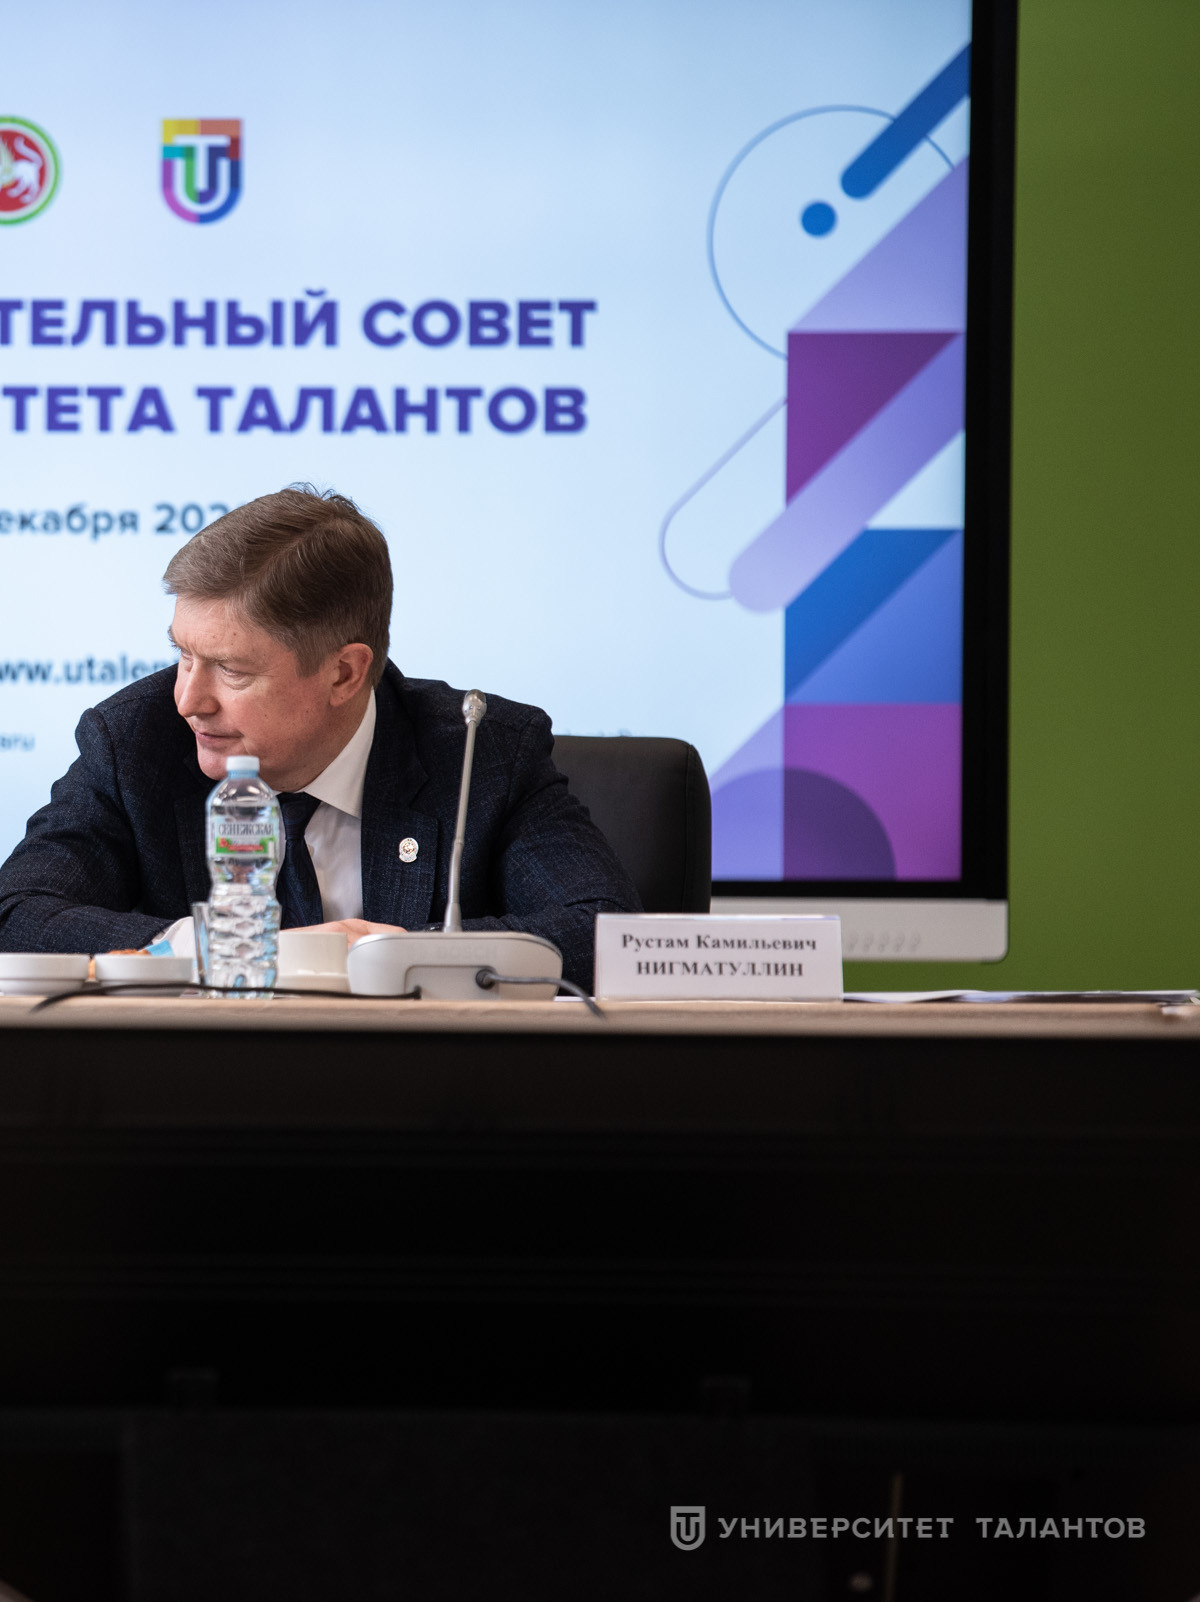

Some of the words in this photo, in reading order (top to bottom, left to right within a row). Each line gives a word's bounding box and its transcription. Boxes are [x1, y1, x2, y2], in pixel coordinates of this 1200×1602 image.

[361, 298, 599, 350] СОВЕТ
[195, 385, 589, 435] ТАЛАНТОВ
[621, 933, 690, 952] Рустам
[695, 934, 818, 950] Камильевич
[636, 961, 804, 977] НИГМАТУЛЛИН
